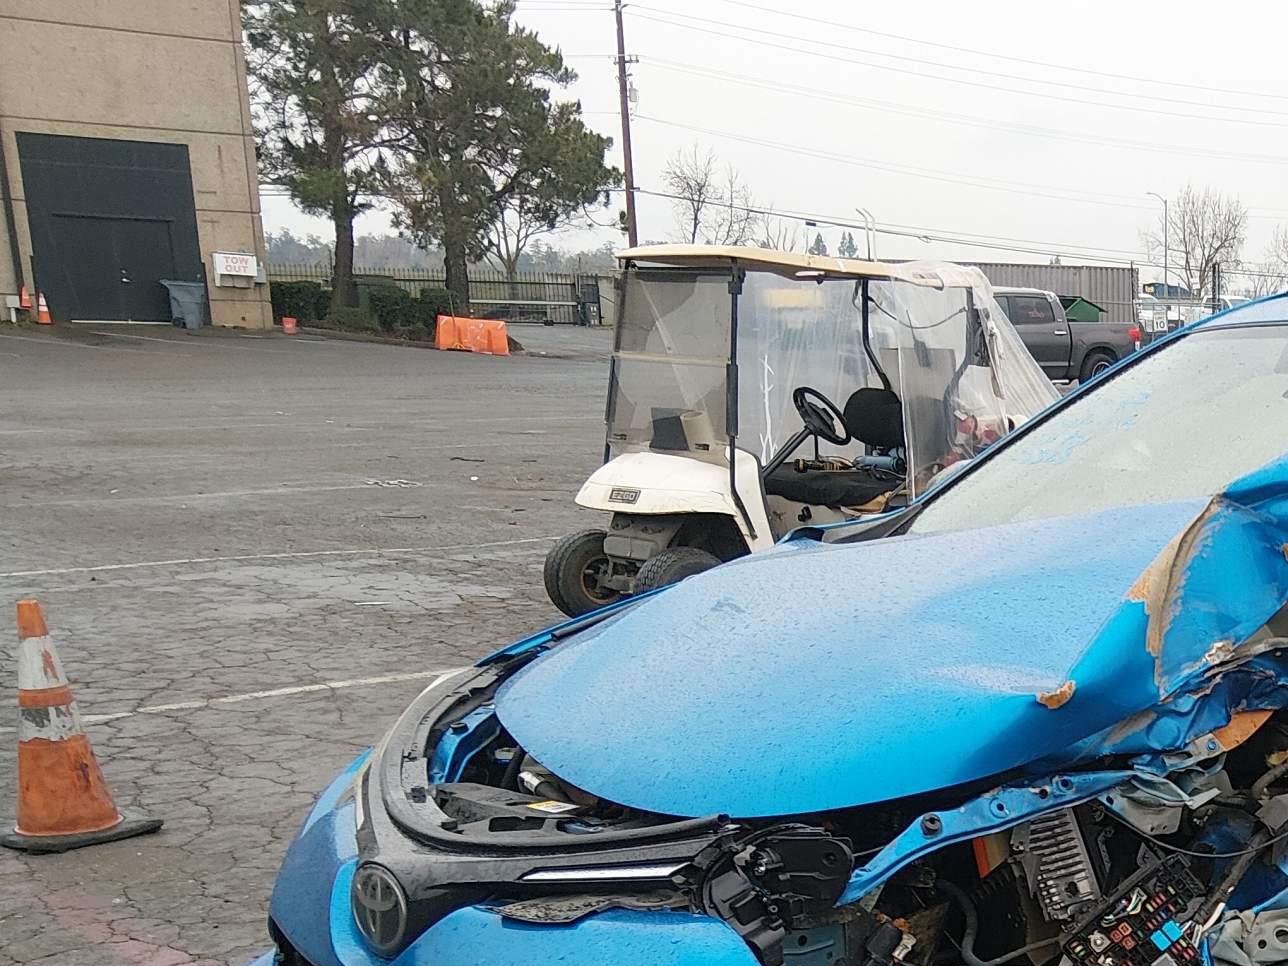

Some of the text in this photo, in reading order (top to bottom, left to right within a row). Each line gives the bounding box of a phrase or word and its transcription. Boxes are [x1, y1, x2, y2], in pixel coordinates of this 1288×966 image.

[223, 256, 249, 264] TOW
[224, 264, 249, 273] OUT
[1155, 320, 1166, 329] 10
